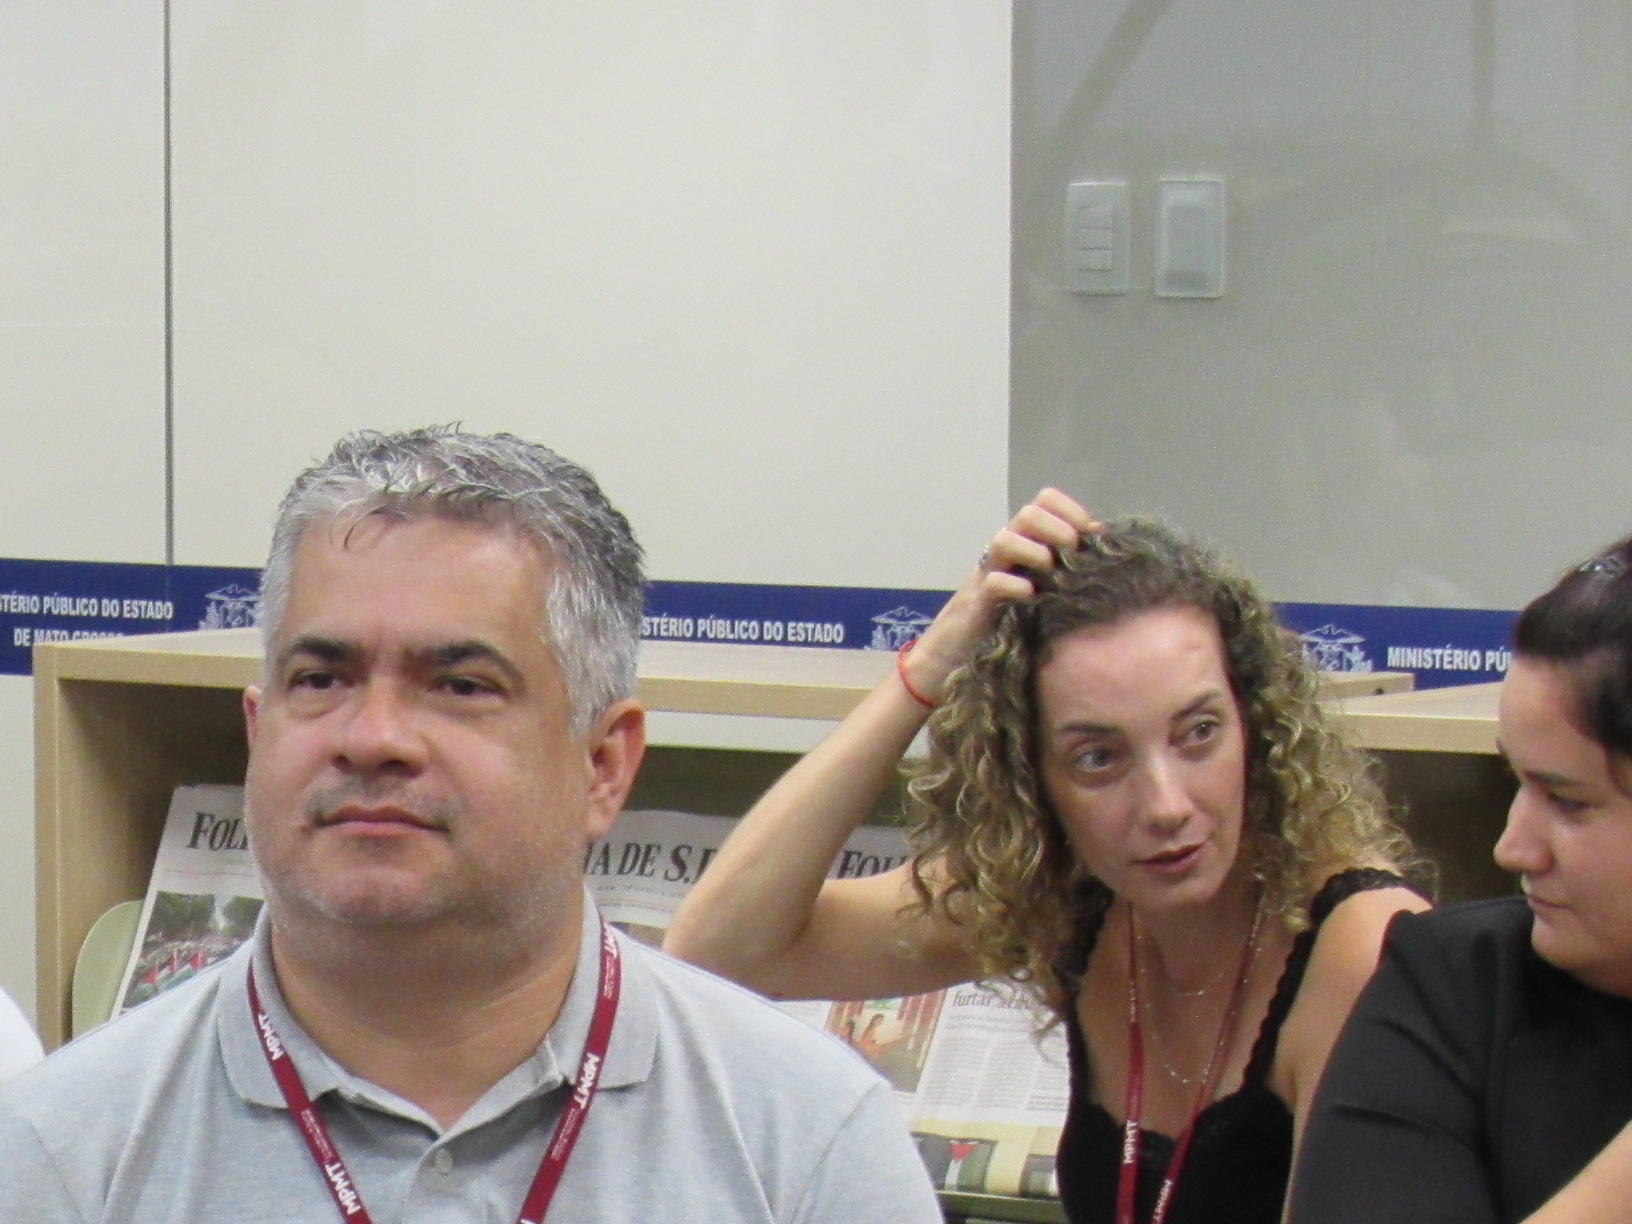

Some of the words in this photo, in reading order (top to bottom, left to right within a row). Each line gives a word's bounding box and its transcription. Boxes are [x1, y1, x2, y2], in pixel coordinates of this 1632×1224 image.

[42, 592, 98, 617] PÚBLICO
[101, 599, 118, 617] DO
[122, 599, 174, 620] ESTADO
[13, 628, 31, 647] DE
[641, 612, 693, 637] STÉRIO
[696, 614, 759, 641] PÚBLICO
[762, 621, 784, 641] DO
[786, 621, 844, 643] ESTADO
[1387, 643, 1481, 671] MINISTÉRIO
[186, 811, 250, 851] FOL
[614, 842, 661, 877] DE
[258, 1013, 284, 1061] MPMT
[574, 1052, 601, 1109] MPMT
[1123, 1119, 1138, 1165] MPMT
[325, 1162, 361, 1216] MPMT
